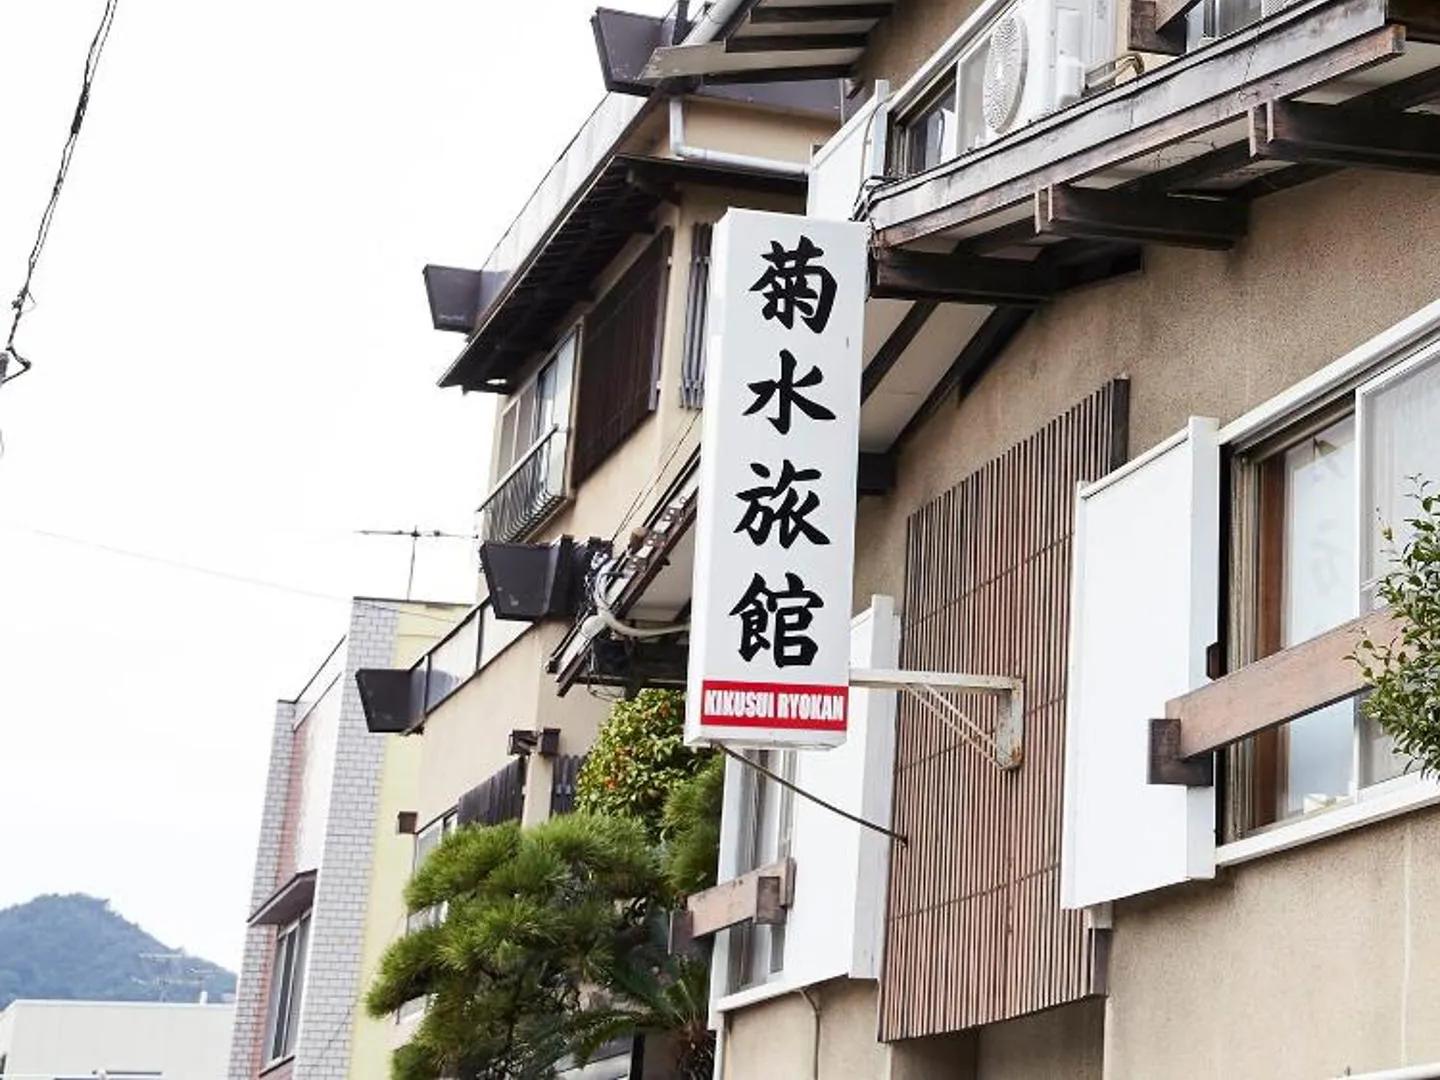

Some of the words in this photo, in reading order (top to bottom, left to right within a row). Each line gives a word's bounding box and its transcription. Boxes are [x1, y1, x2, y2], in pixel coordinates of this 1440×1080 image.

[728, 235, 838, 669] 菊水旅館
[704, 690, 775, 717] KIKUSUI
[777, 693, 844, 720] RYOKAN
